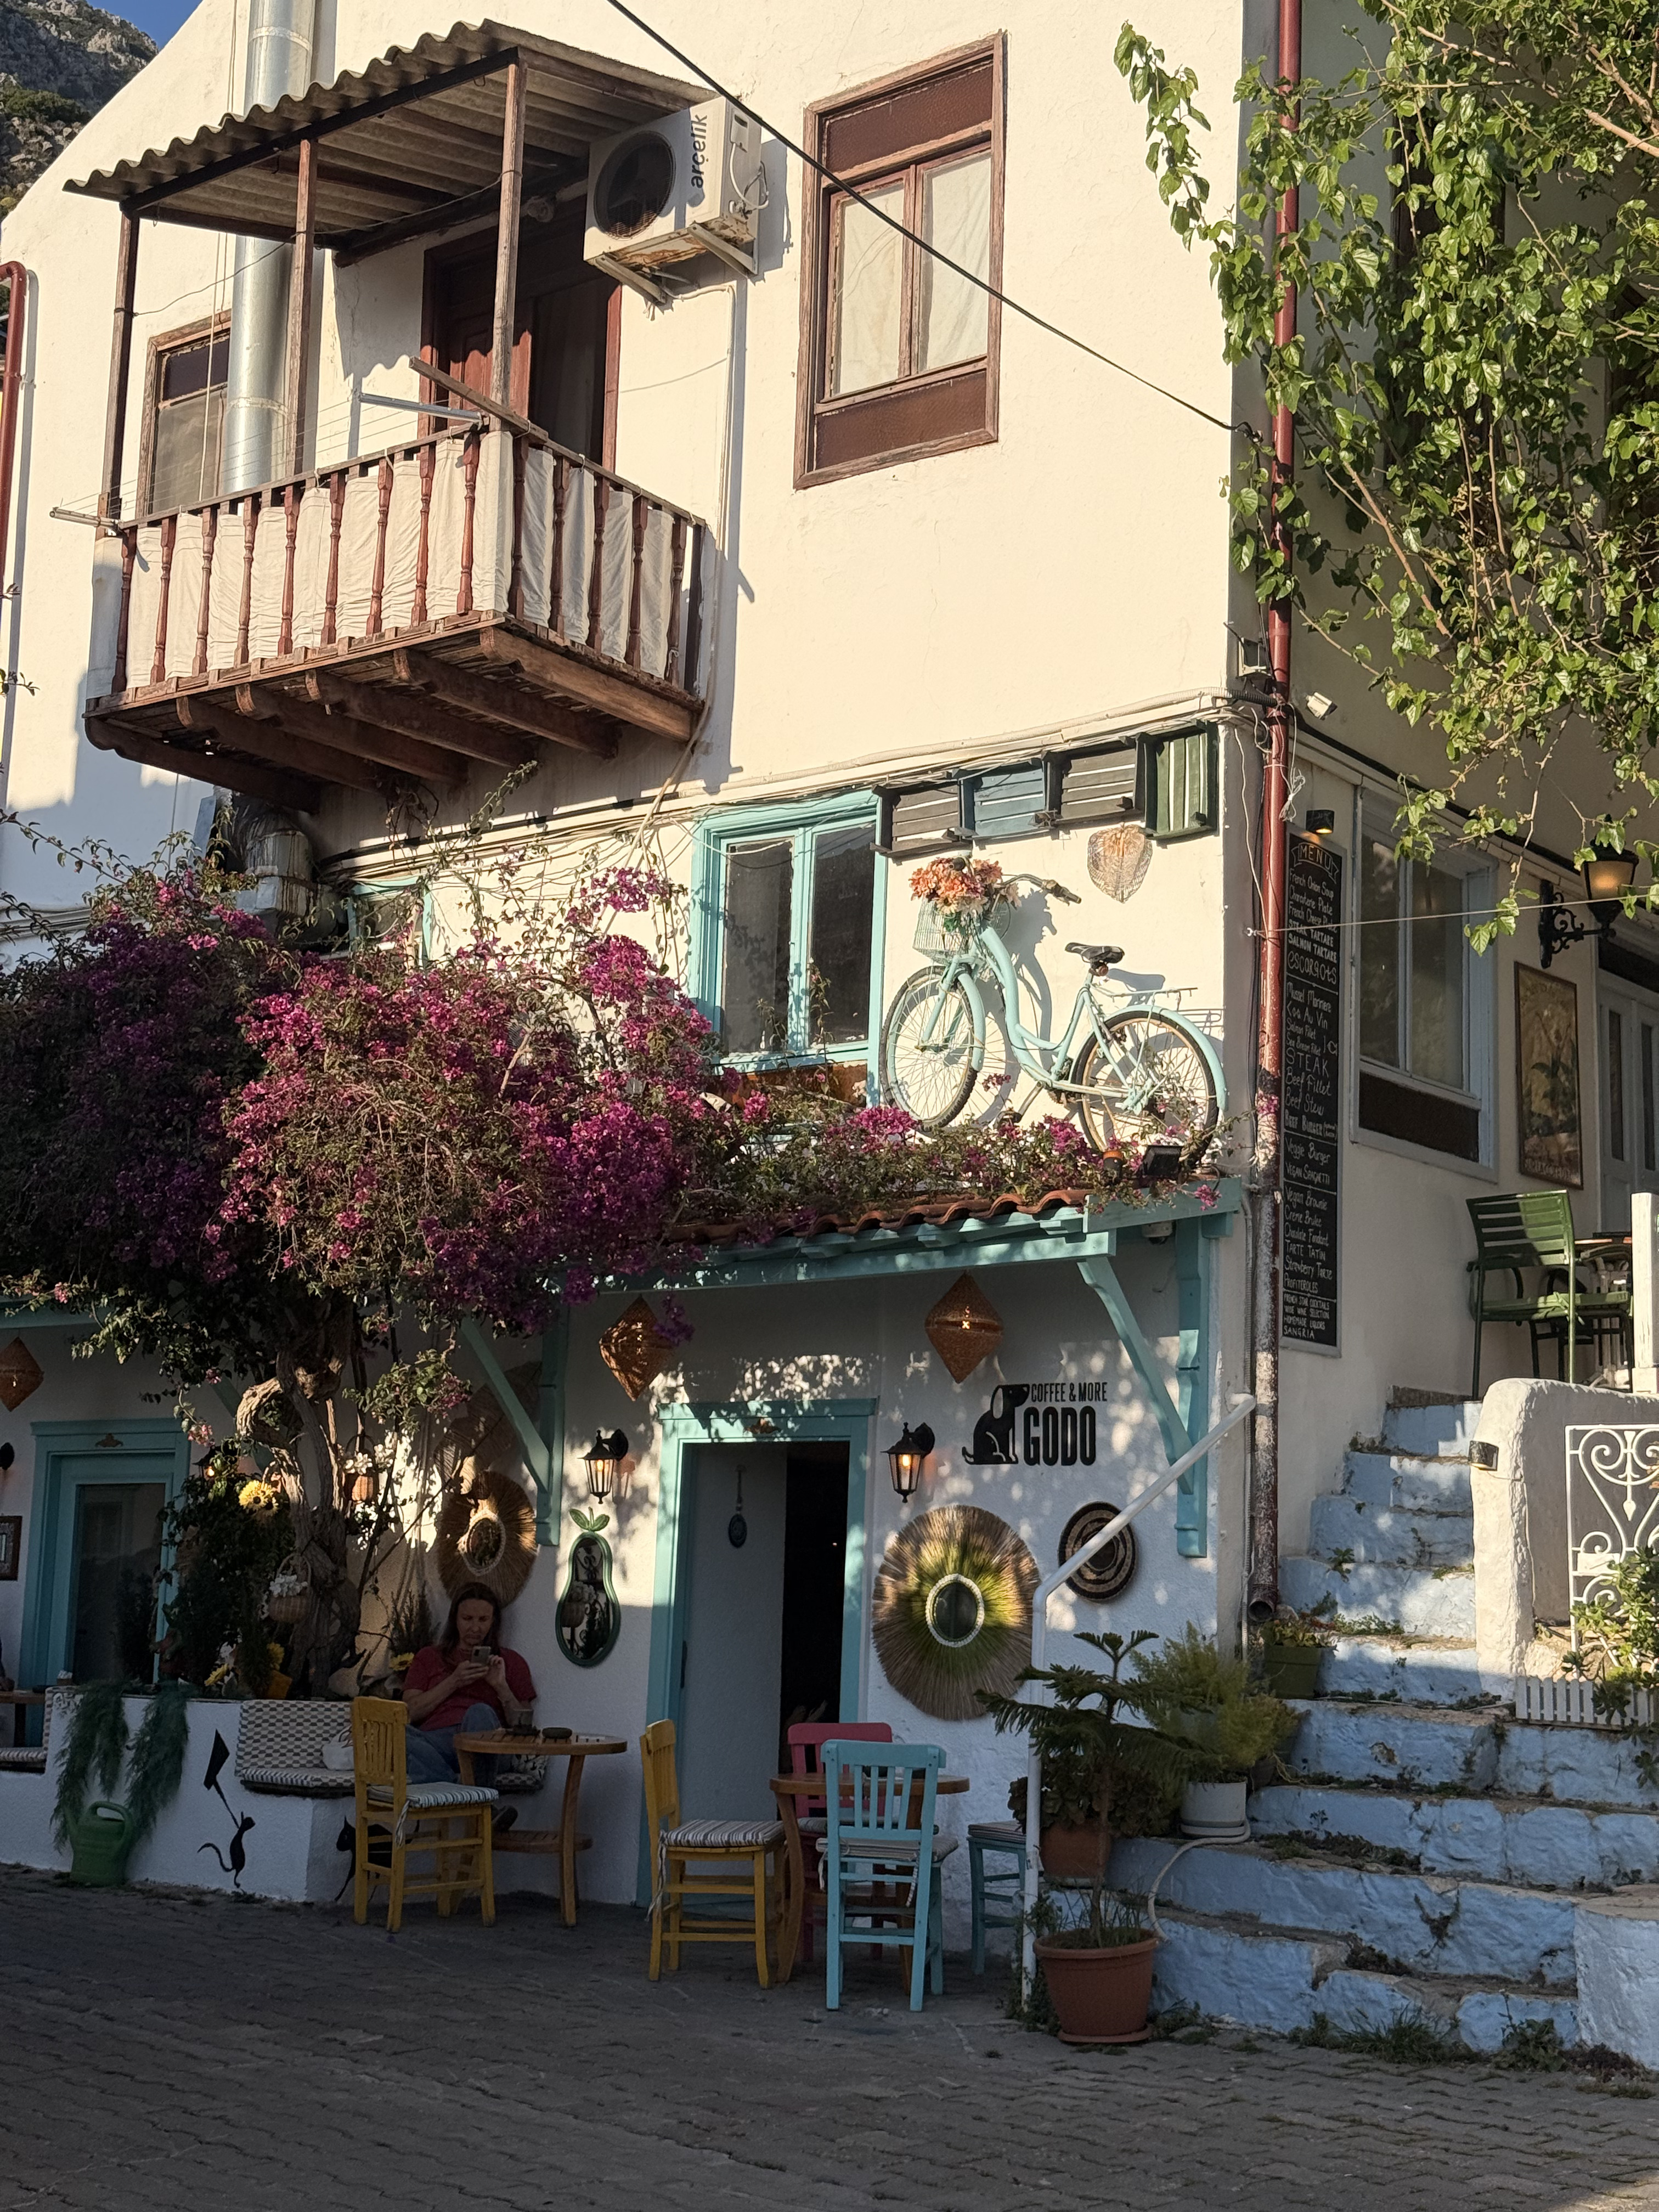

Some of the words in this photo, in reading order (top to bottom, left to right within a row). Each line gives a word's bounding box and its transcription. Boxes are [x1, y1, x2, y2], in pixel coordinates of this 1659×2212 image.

[691, 114, 708, 189] arçelik
[1300, 845, 1331, 870] MENU
[1290, 868, 1306, 887] French
[1322, 882, 1334, 901] Soup
[1289, 901, 1305, 920] French
[1318, 896, 1333, 916] Plate
[1288, 933, 1311, 952] SALMON
[1313, 943, 1337, 963] TARTARE
[1310, 929, 1334, 947] TARTARE
[1304, 1007, 1313, 1024] Au
[1316, 1010, 1328, 1029] Vin
[1286, 1047, 1329, 1078] STEAK
[1285, 1066, 1305, 1091] Beef
[1306, 1074, 1332, 1096] Fillet
[1285, 1086, 1302, 1110] Beef
[1304, 1093, 1324, 1116] Stew
[1285, 1137, 1305, 1160] Veggie
[1308, 1142, 1330, 1166] Burger
[1285, 1161, 1302, 1178] VEGAN
[1285, 1185, 1304, 1209] Vegan
[1285, 1239, 1304, 1256] TARTE
[1307, 1245, 1325, 1261] TATIN
[1284, 1325, 1315, 1340] SANGRIA
[1031, 1383, 1066, 1403] COFFEE
[1069, 1383, 1076, 1402] &
[1078, 1381, 1108, 1402] MORE
[1023, 1406, 1096, 1466] GODO
